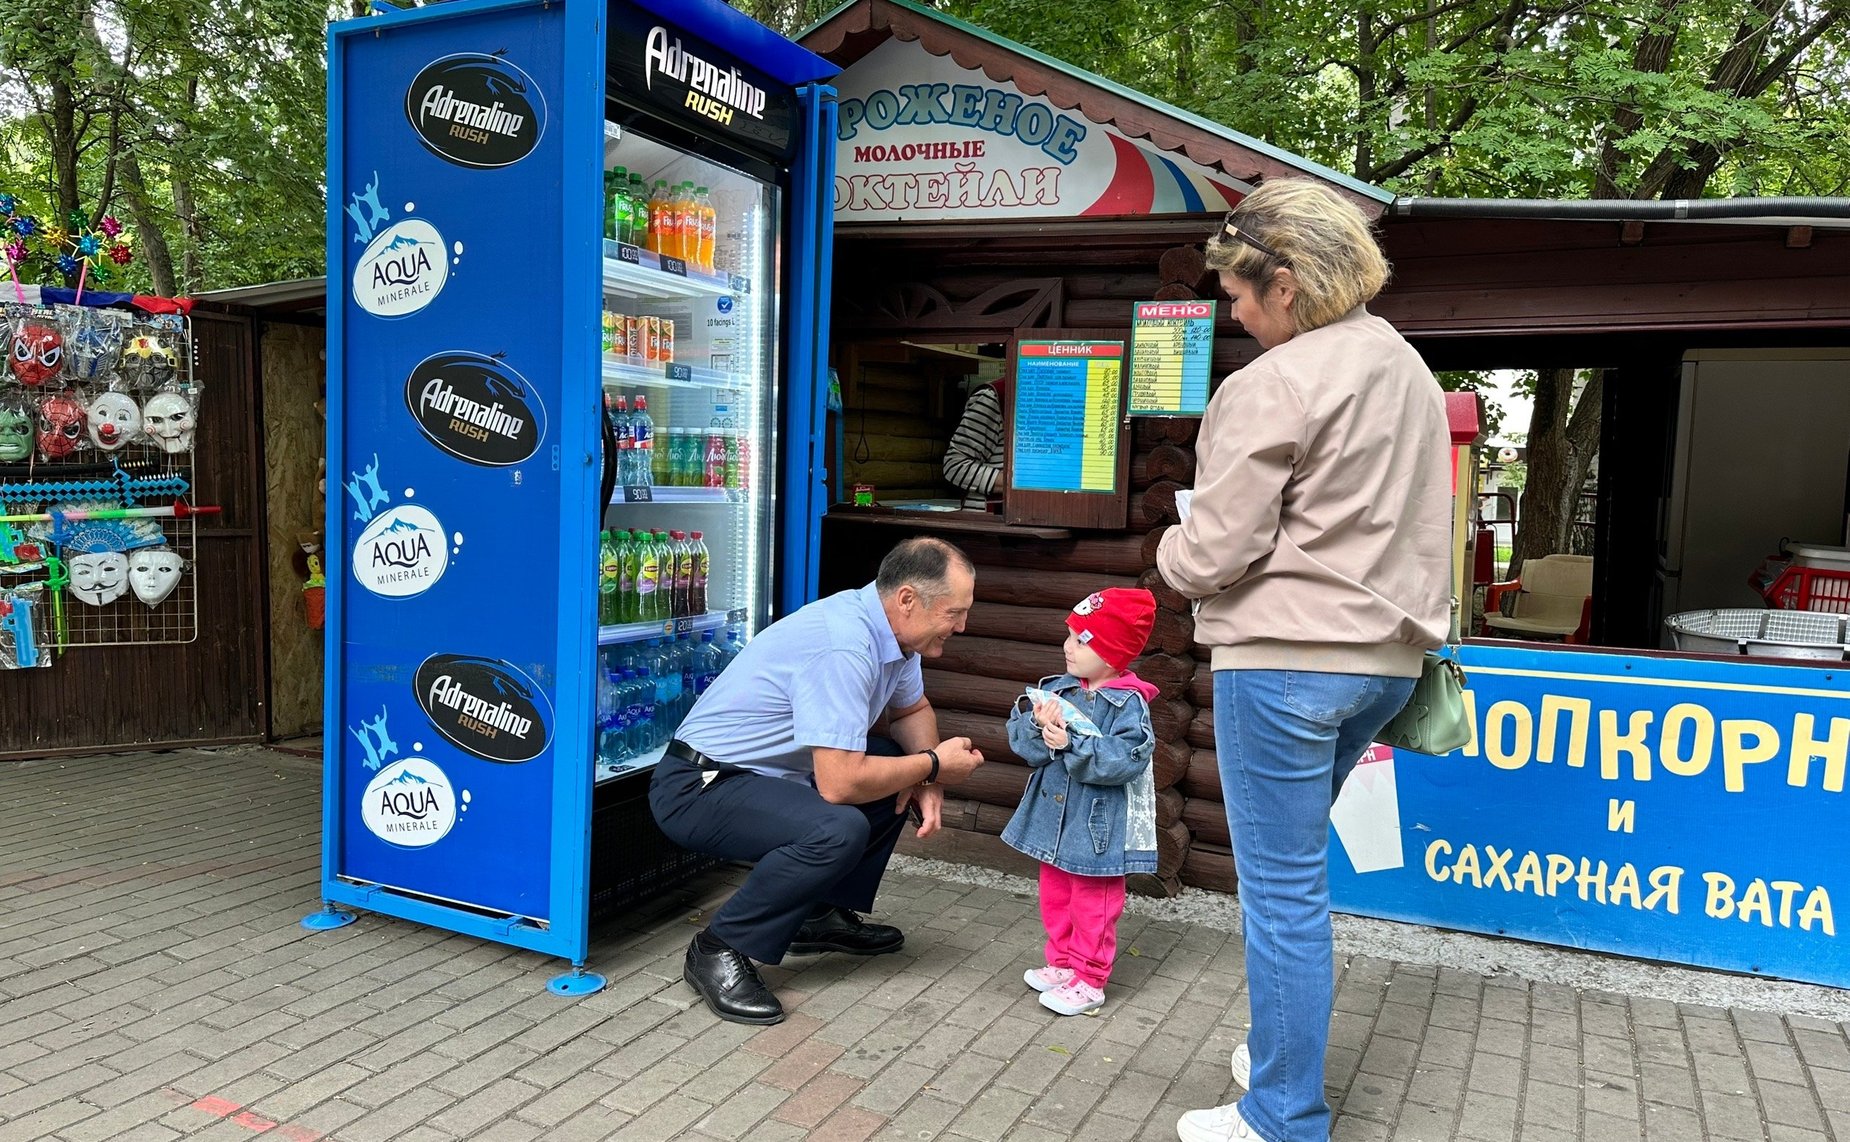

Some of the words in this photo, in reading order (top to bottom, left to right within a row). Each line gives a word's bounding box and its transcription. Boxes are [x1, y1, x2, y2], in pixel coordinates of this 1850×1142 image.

[645, 26, 766, 120] Adrenaline
[420, 84, 524, 138] Adrenaline
[684, 90, 734, 126] RUSH
[448, 124, 491, 145] RUSH
[853, 140, 986, 164] МОЛОЧНЫЕ
[372, 247, 432, 290] AQUA
[376, 281, 430, 307] MINERALE
[1142, 306, 1208, 316] МЕНЮ
[1048, 343, 1093, 355] ЦЕННИК
[420, 378, 524, 441] Adrenaline
[448, 419, 490, 443] RUSH
[372, 532, 431, 568] AQUA
[376, 566, 430, 585] MINERALE
[428, 675, 533, 740] Adrenaline
[458, 714, 498, 740] RUSH
[381, 786, 440, 820] AQUA
[386, 820, 438, 833] MINERALE
[1424, 839, 1685, 915] САХАРНАЯ
[1702, 871, 1837, 937] ВАТА
